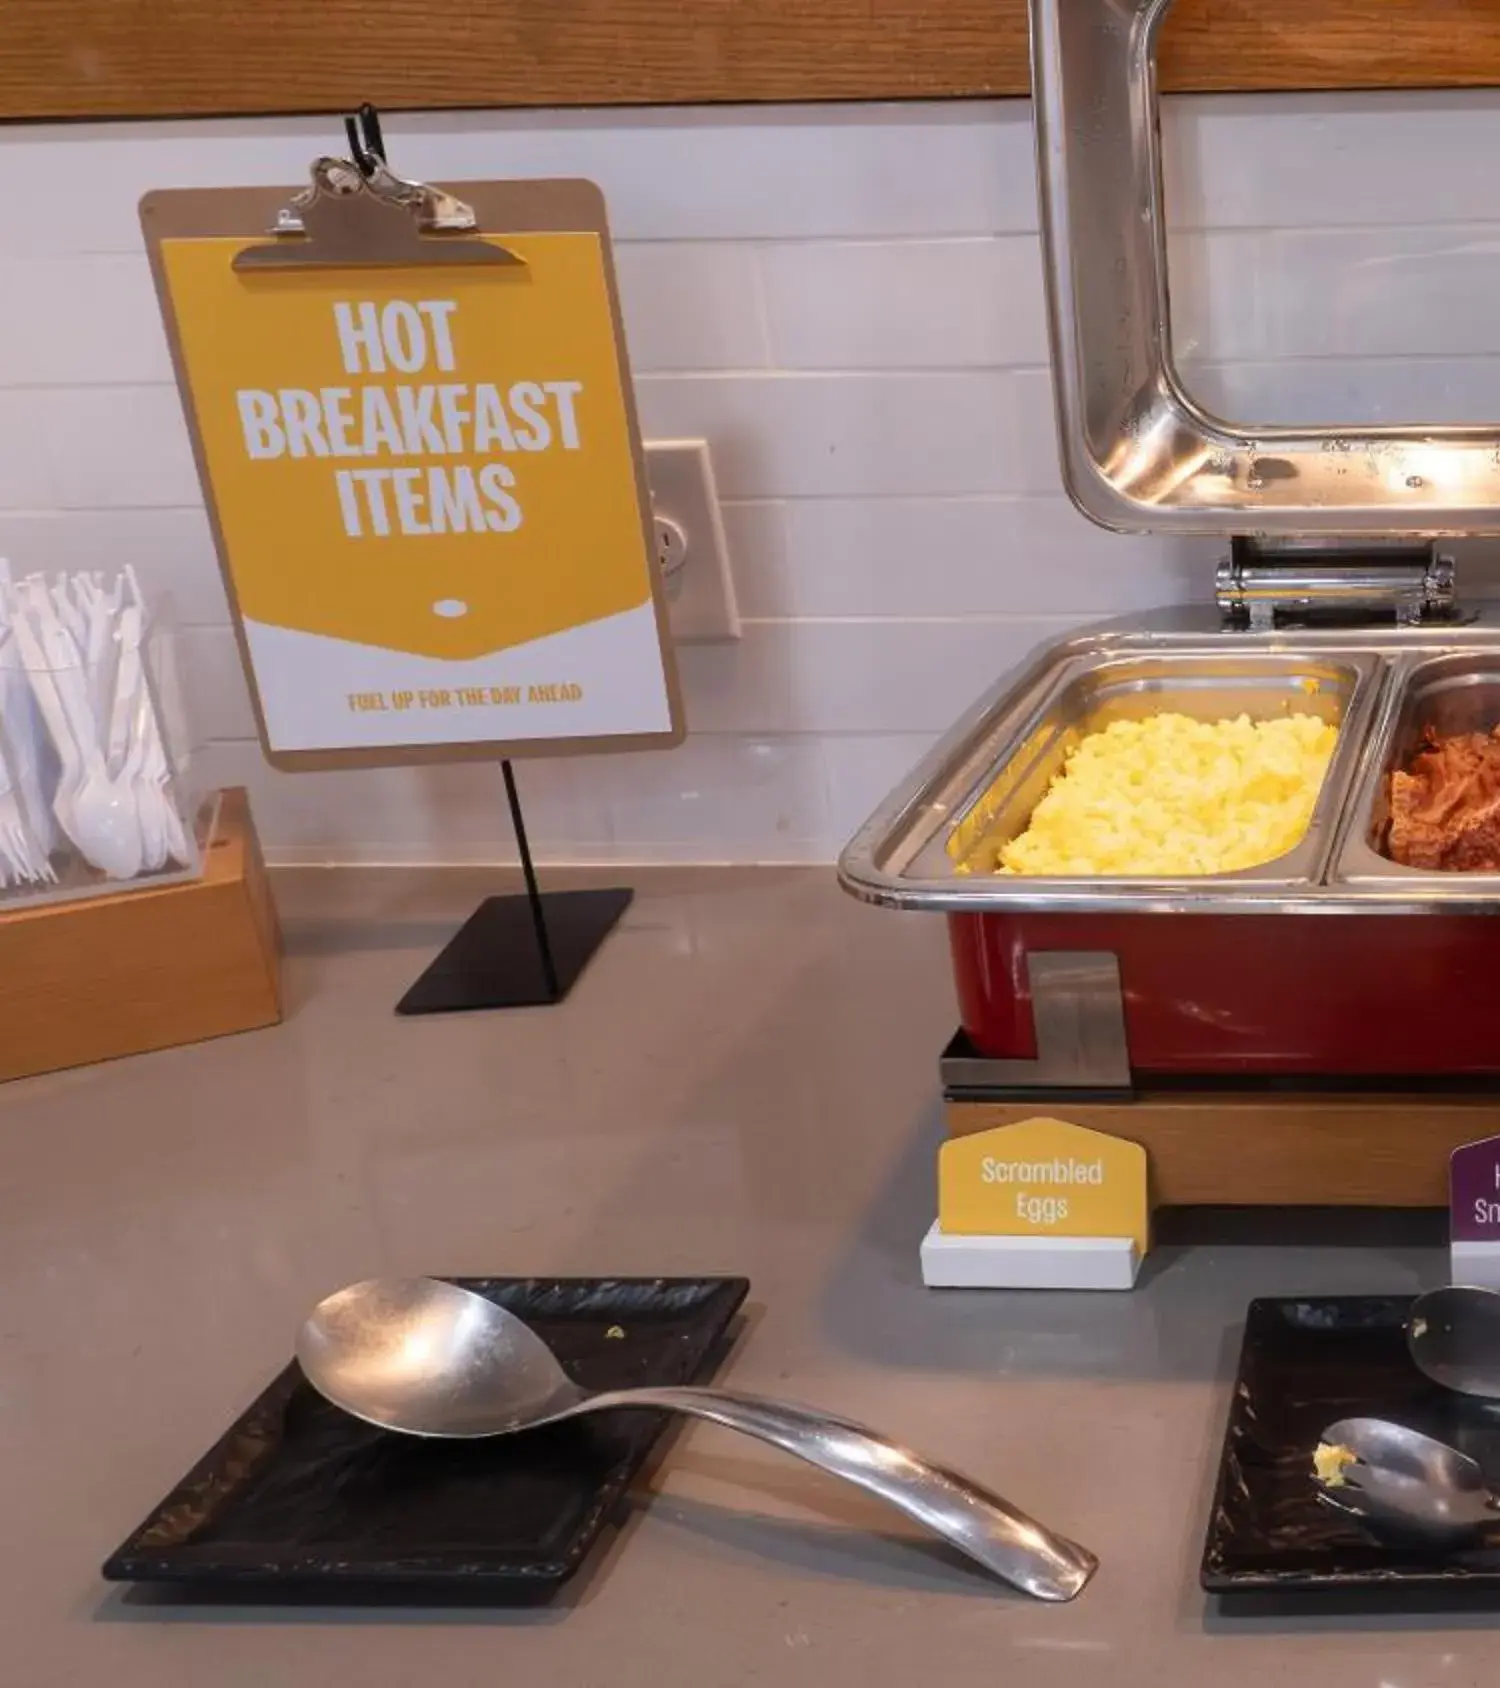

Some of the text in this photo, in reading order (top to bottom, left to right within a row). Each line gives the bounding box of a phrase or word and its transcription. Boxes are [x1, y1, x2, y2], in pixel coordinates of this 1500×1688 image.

[333, 300, 457, 374] HOT
[235, 380, 583, 460] BREAKFAST
[334, 464, 522, 537] ITEMS
[347, 683, 583, 712] FUEL UP FOR THE DAY AHEAD
[980, 1156, 1104, 1184] Scrambled
[1015, 1192, 1068, 1225] Eggs
